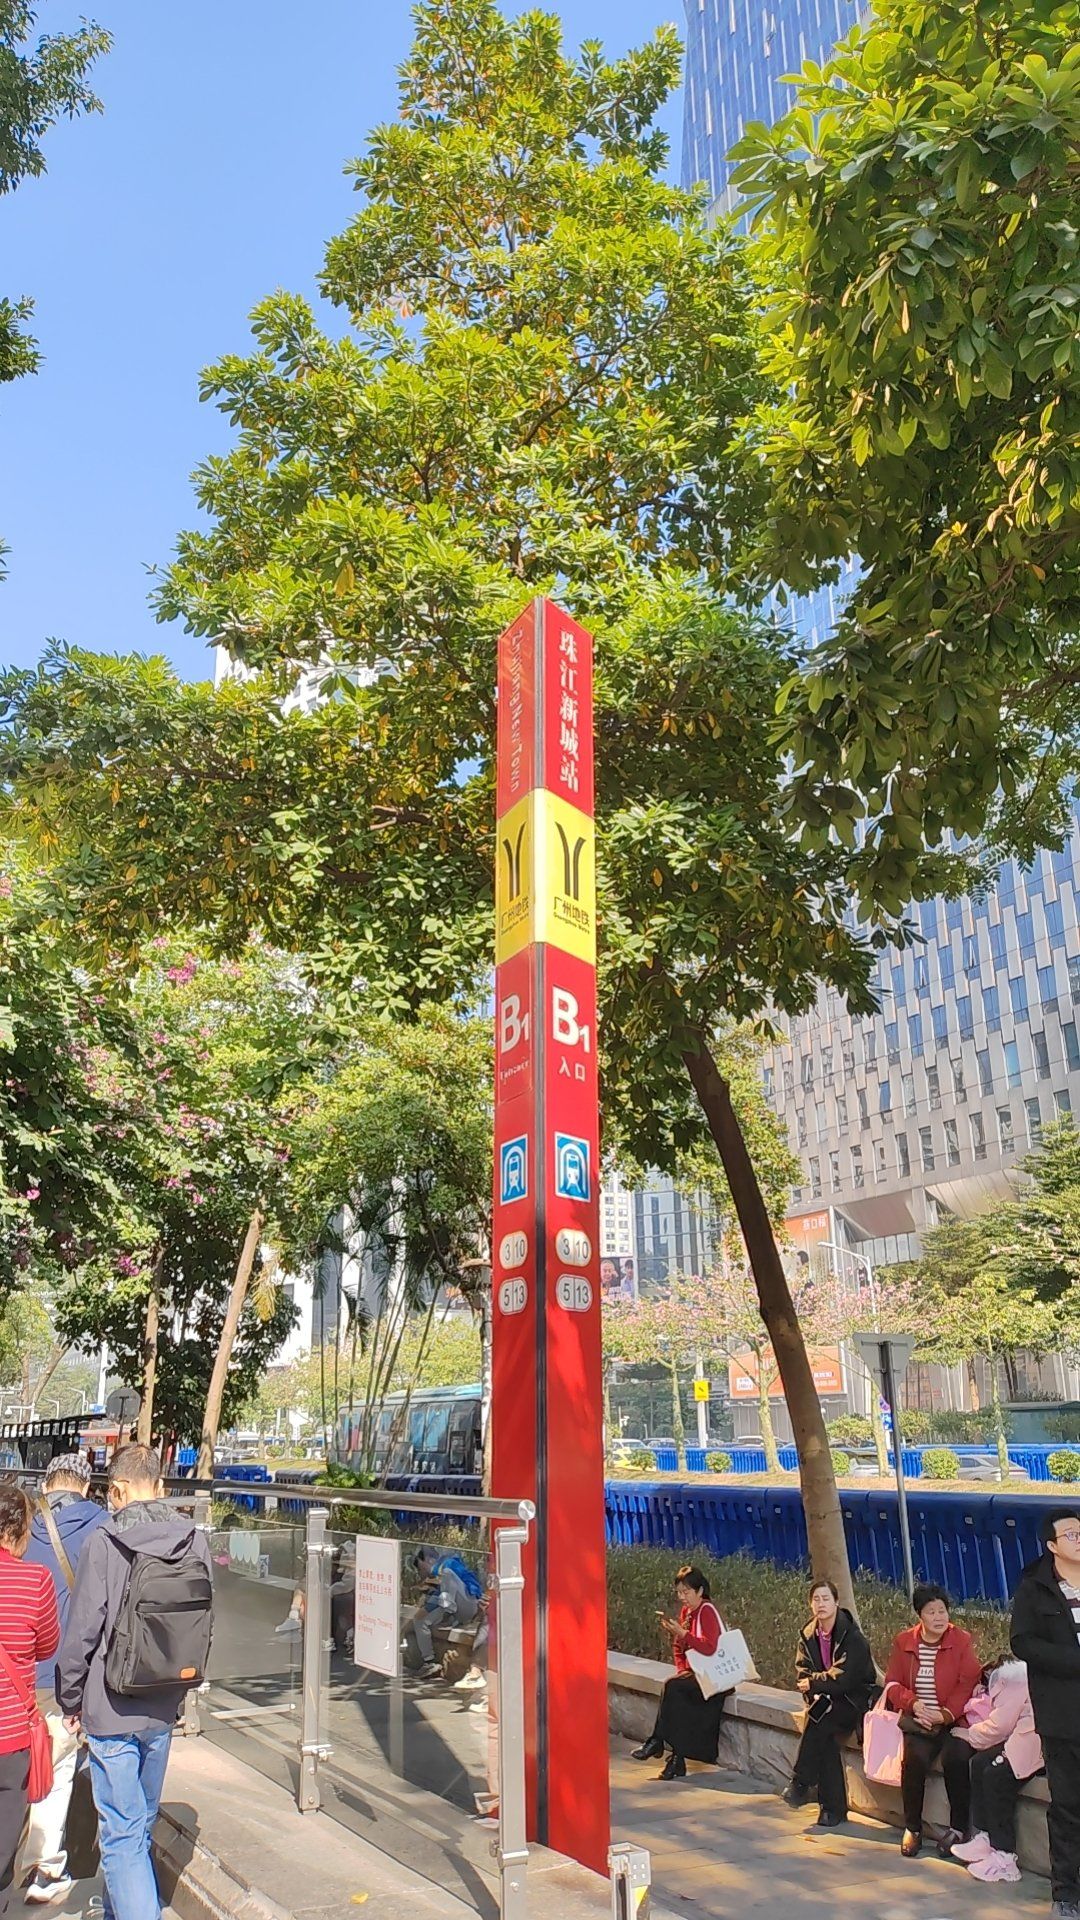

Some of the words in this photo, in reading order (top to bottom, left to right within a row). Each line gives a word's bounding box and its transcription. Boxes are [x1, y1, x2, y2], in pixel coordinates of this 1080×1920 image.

[511, 703, 522, 742] New
[560, 630, 579, 793] 珠江新城站
[511, 743, 522, 792] Town
[553, 896, 589, 927] 广州地铁
[501, 994, 530, 1054] B1
[552, 985, 590, 1054] B1
[559, 1056, 586, 1082] 入口
[505, 1244, 511, 1261] 3
[515, 1239, 525, 1258] 10
[563, 1238, 569, 1256] 3
[575, 1239, 589, 1259] 10
[504, 1288, 510, 1306] 5
[514, 1285, 525, 1304] 13
[563, 1283, 570, 1301] 5
[576, 1285, 589, 1304] 13
